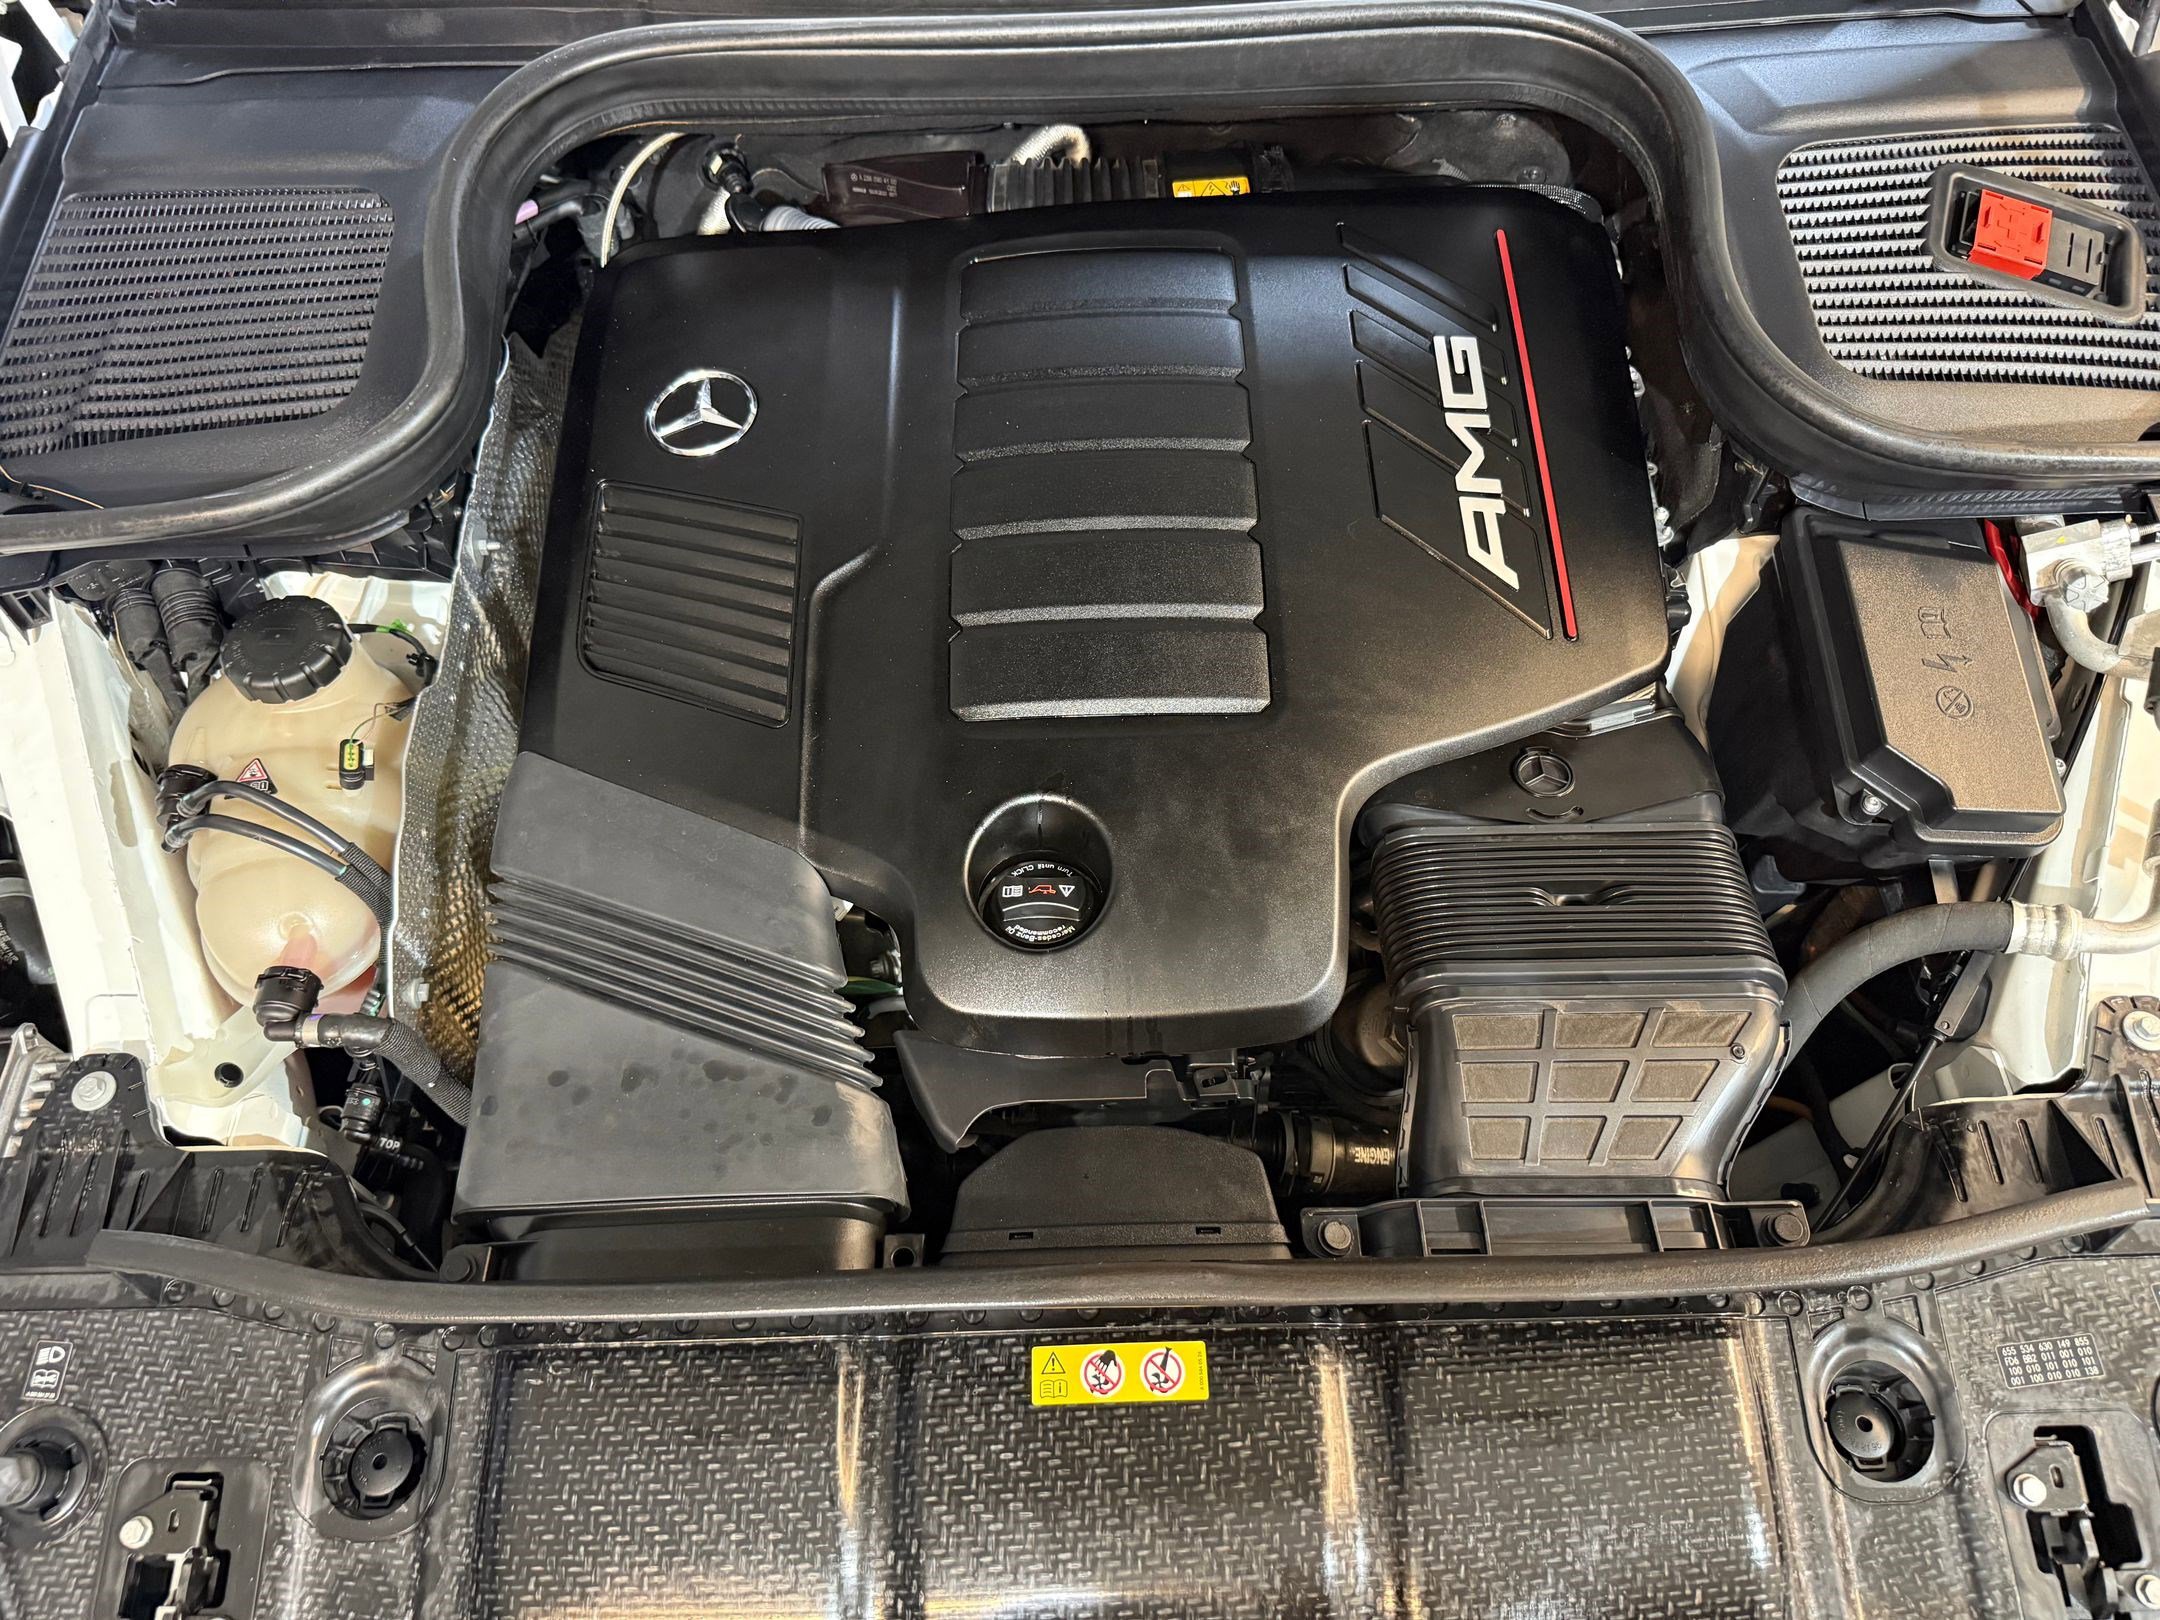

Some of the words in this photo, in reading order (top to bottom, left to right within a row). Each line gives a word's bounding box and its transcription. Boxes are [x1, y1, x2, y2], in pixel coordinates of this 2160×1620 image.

[1433, 336, 1519, 592] AMG
[1011, 865, 1034, 876] CLICK
[1057, 866, 1073, 877] Turn
[1005, 926, 1015, 935] Oil
[1015, 925, 1065, 935] recommended
[1016, 925, 1075, 941] Mercedes-Benz
[380, 1137, 400, 1149] TOP
[1354, 1147, 1390, 1165] ENGINE
[2002, 1346, 2016, 1356] 655
[2020, 1344, 2035, 1354] 534
[2039, 1341, 2053, 1351] 630
[2057, 1339, 2071, 1349] 149
[2074, 1337, 2089, 1346] 855
[2041, 1351, 2056, 1361] 011
[2059, 1349, 2074, 1359] 001
[2077, 1346, 2093, 1357] 010
[2008, 1366, 2023, 1376] 100
[2026, 1364, 2041, 1373] 010
[2044, 1361, 2059, 1371] 101
[2062, 1359, 2078, 1369] 010
[2081, 1356, 2096, 1366] 101
[2010, 1375, 2025, 1386] 001
[2029, 1373, 2044, 1383] 100
[2047, 1371, 2062, 1381] 010
[2065, 1368, 2081, 1378] 010
[2084, 1366, 2099, 1376] 138
